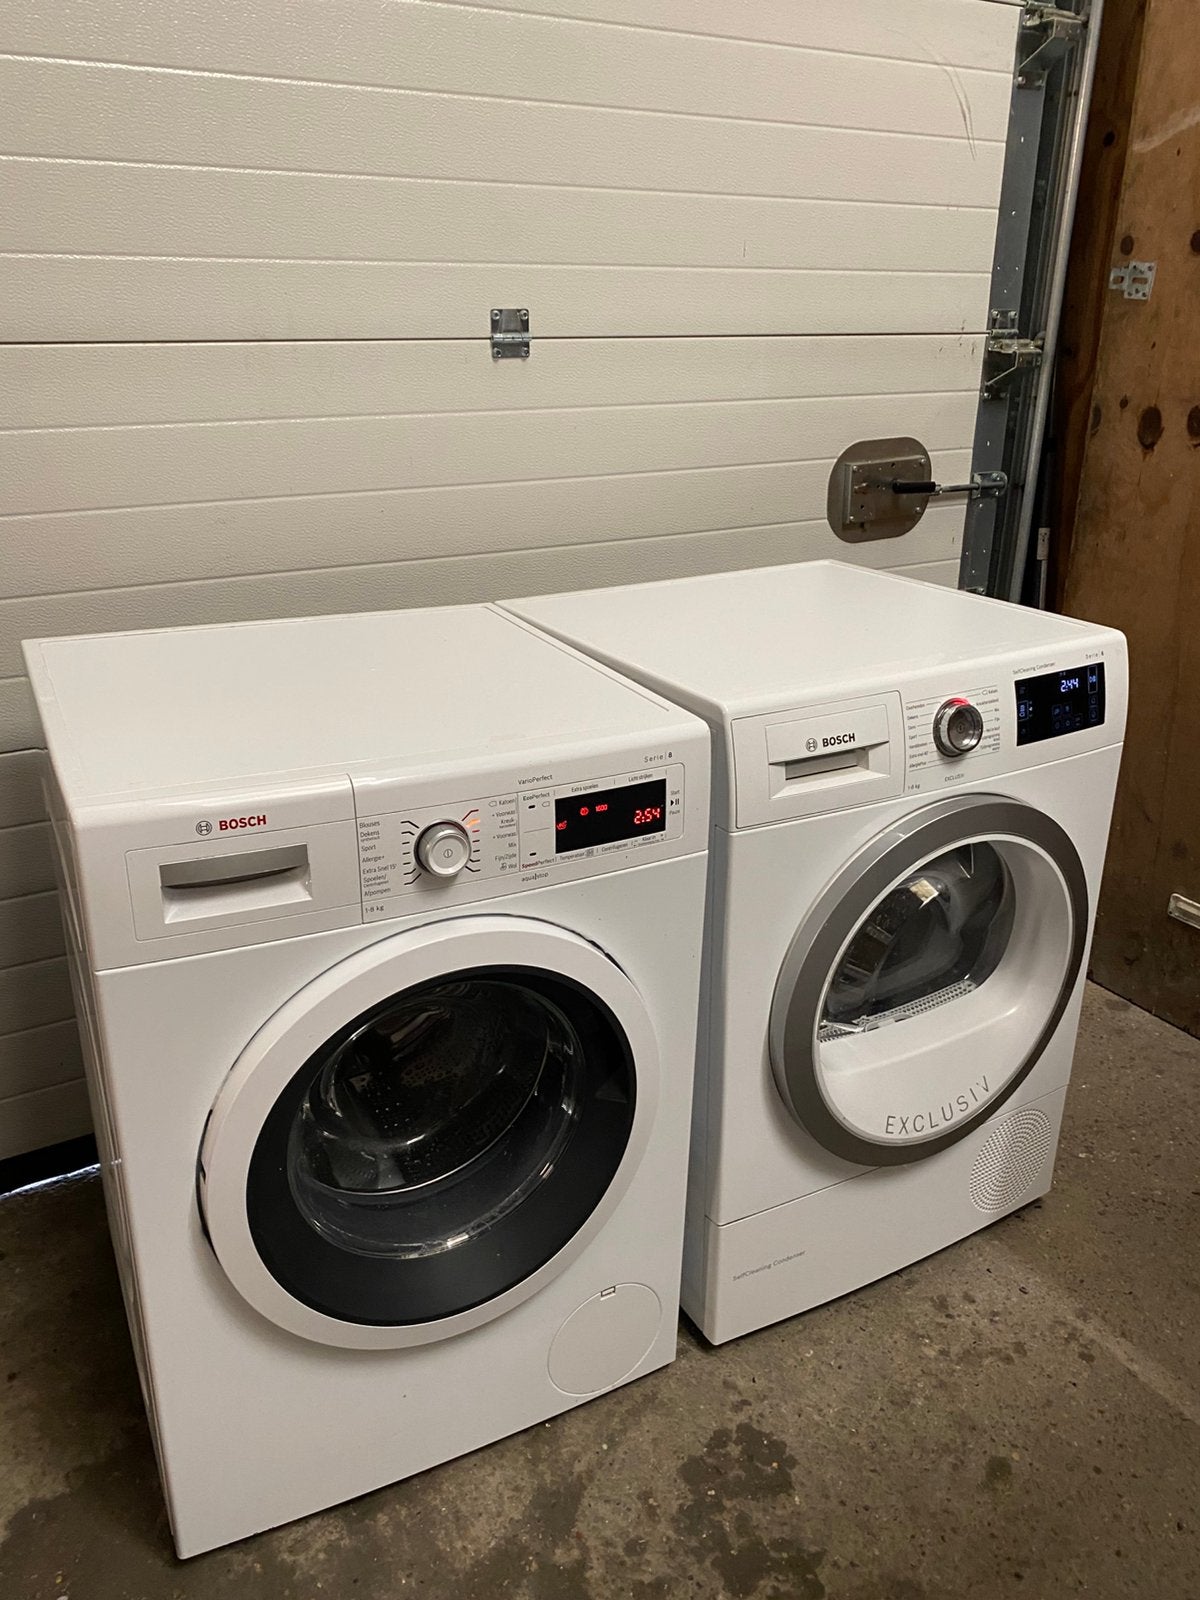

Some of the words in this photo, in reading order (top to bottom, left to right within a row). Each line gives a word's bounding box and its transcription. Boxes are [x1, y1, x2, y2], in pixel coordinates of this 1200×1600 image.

[1060, 678, 1079, 693] 2:44
[822, 732, 856, 748] BOSCH
[643, 754, 664, 763] Serie
[667, 751, 673, 759] 8
[518, 774, 553, 785] VarioPerfect
[522, 792, 550, 801] EcoPerfect
[634, 807, 661, 825] 2:54
[218, 814, 267, 831] BOSCH
[359, 820, 380, 829] Blouses
[360, 830, 380, 838] Dekens
[361, 844, 376, 853] Sport
[521, 858, 555, 869] SpeedPerfect
[362, 866, 377, 875] Extra
[377, 864, 389, 872] Snel
[364, 887, 391, 897] Afpompen
[885, 1075, 990, 1135] EXCLUSIV
